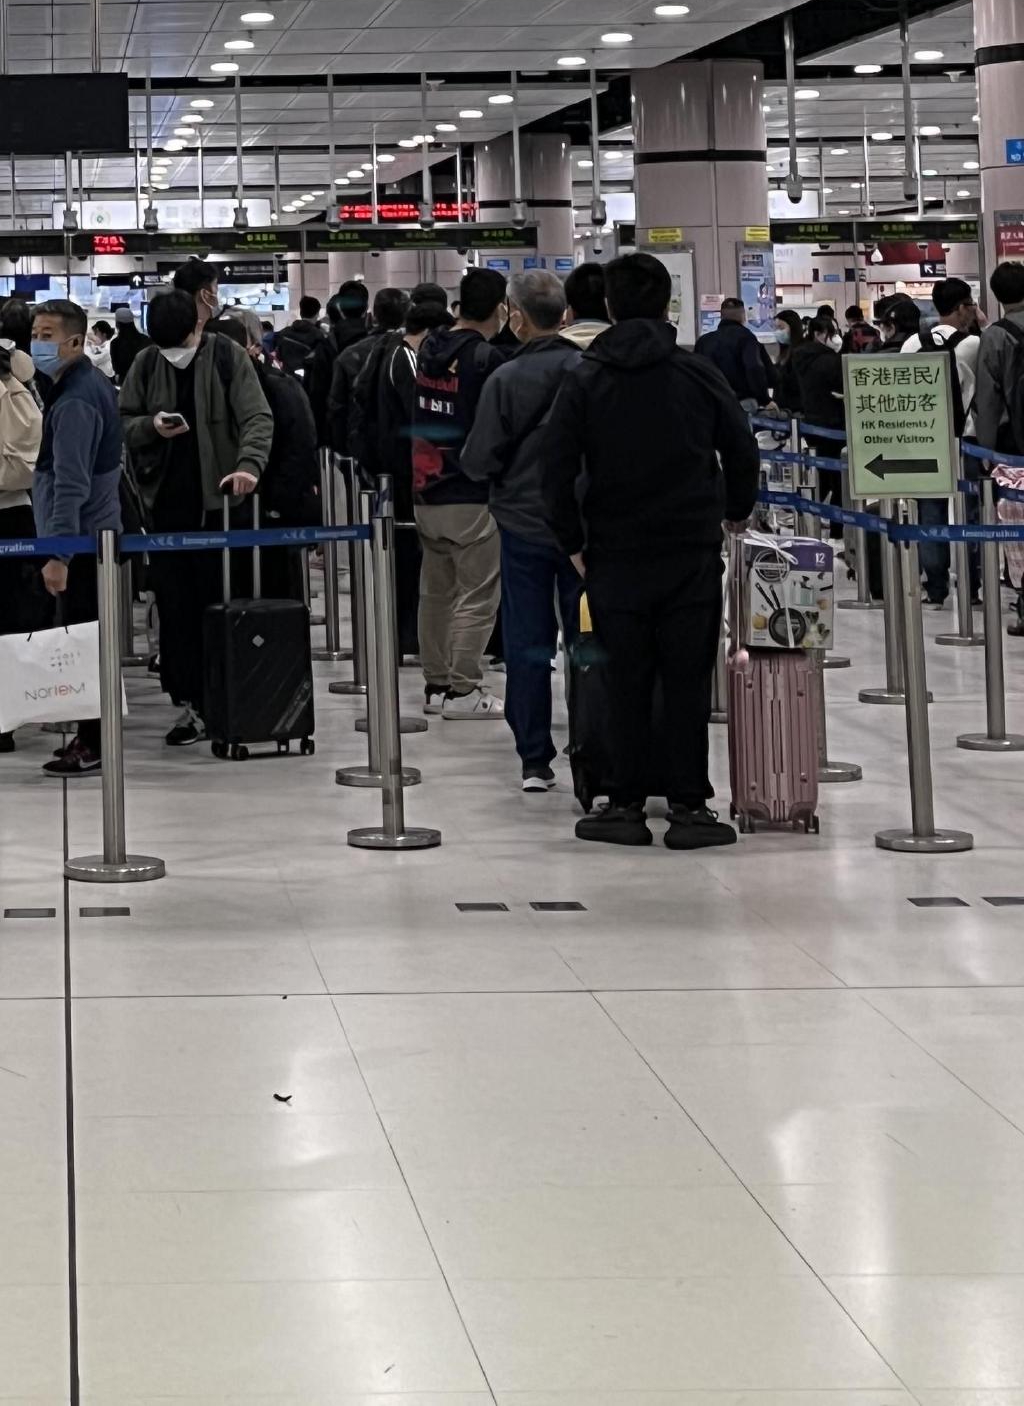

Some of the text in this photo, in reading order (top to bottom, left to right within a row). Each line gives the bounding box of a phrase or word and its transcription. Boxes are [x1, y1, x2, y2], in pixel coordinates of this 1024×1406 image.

[855, 393, 938, 413] 其他訪客
[861, 420, 876, 430] HK
[878, 419, 928, 429] Residents
[864, 434, 935, 444] Other Visitors
[815, 552, 826, 564] 12
